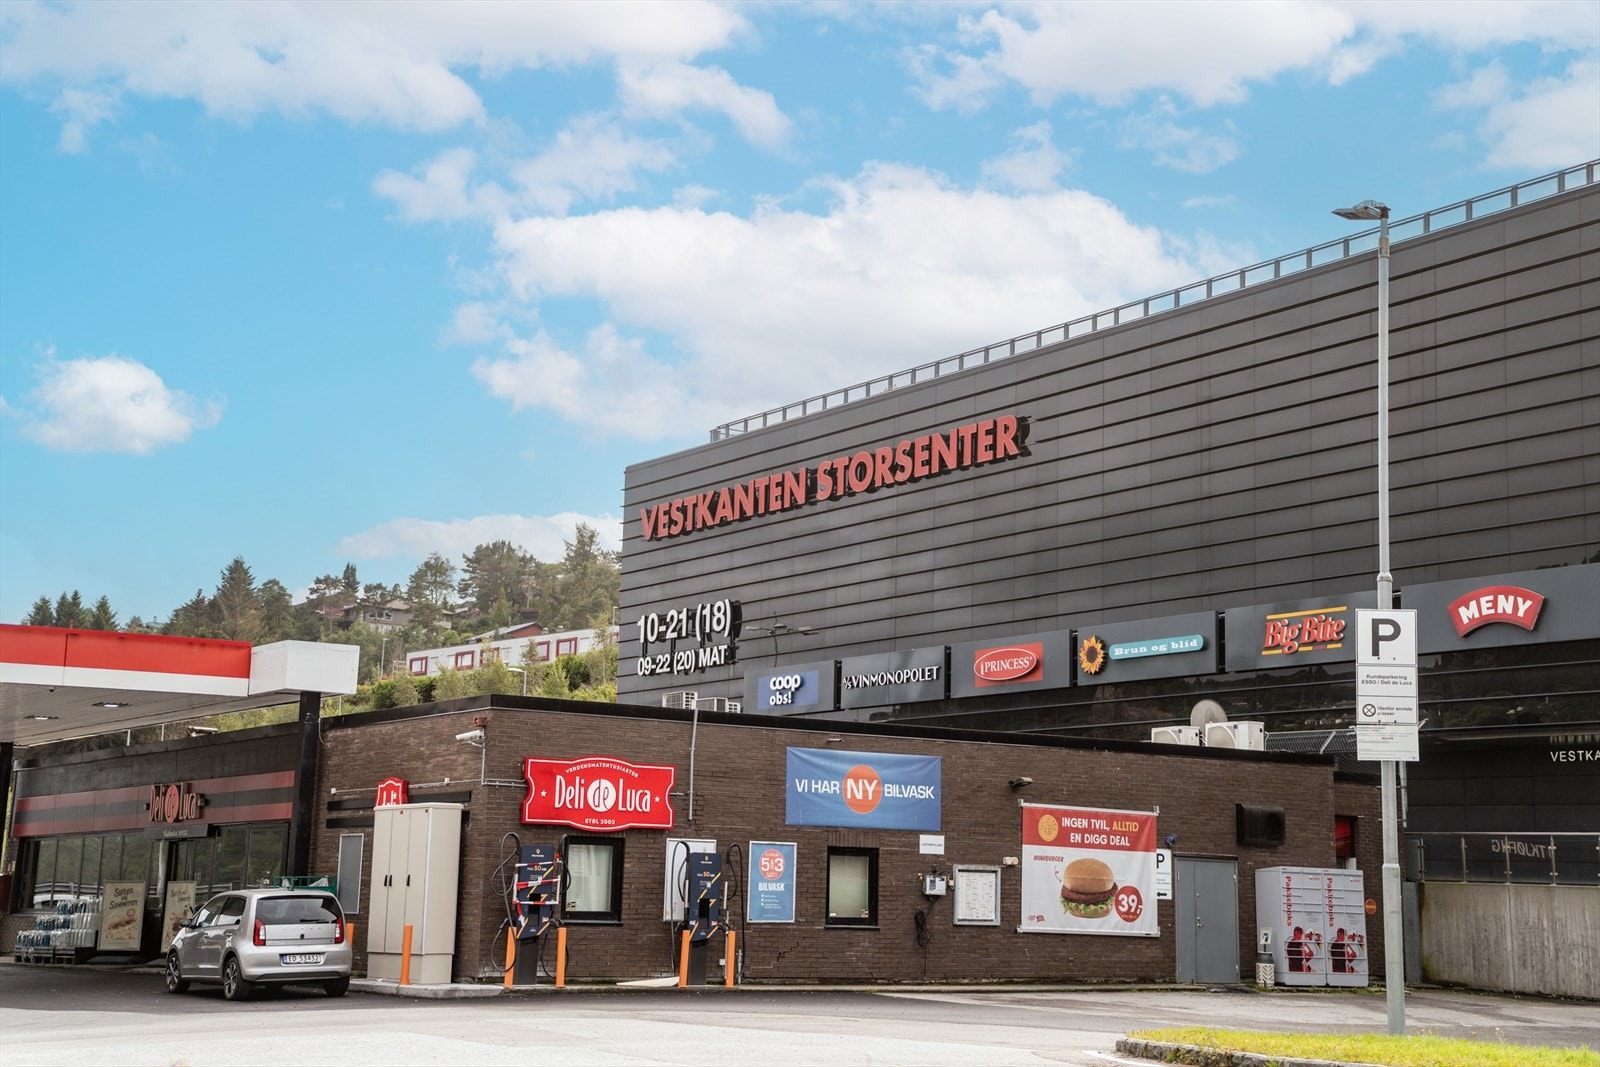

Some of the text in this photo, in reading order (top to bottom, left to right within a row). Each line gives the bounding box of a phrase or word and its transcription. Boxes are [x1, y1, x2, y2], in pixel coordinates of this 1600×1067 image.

[639, 415, 1022, 541] VESTKANTEN STORSENTER
[1458, 594, 1533, 624] MENY
[637, 599, 732, 643] 10-21 (18)
[1263, 614, 1346, 655] Big Bite
[1371, 618, 1401, 657] P
[1113, 639, 1198, 656] Brun og blid
[637, 644, 728, 676] 09-22 (20) MAT
[769, 674, 801, 692] coop
[851, 665, 940, 689] VINMONOPOLET
[769, 691, 792, 706] obs!
[554, 775, 651, 812] Deli de Luca
[795, 778, 935, 801] VI HAR NY BILVASK
[149, 784, 165, 822] Deli
[179, 782, 197, 820] Luca
[1061, 817, 1089, 829] INGEN
[1091, 819, 1110, 832] TVIL,
[1112, 820, 1139, 832] ALLTID
[1070, 833, 1130, 847] EN DIGG DEAL
[761, 857, 770, 872] 5
[774, 858, 784, 872] 3
[1033, 855, 1064, 863] MINIBURGER
[1156, 853, 1166, 869] P
[758, 882, 785, 892] BILVASK
